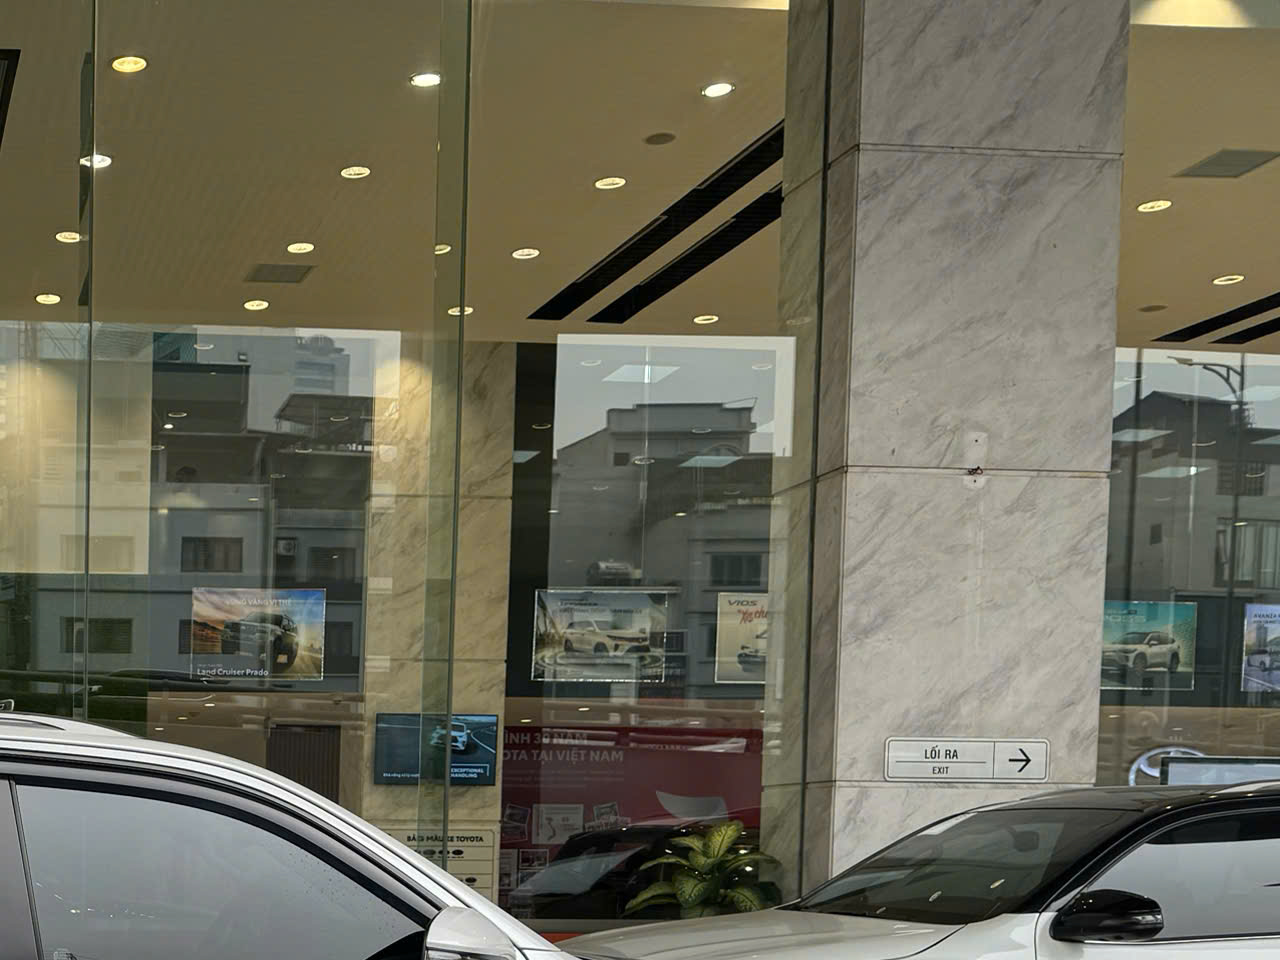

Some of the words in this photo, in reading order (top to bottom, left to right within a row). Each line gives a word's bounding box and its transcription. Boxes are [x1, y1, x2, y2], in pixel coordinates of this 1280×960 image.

[217, 668, 245, 676] Cruiser
[246, 668, 269, 676] Prado
[554, 746, 587, 765] VIỆT
[590, 751, 624, 762] NAM
[924, 745, 940, 760] LỐI
[945, 749, 958, 760] RA
[932, 766, 949, 775] EXIT
